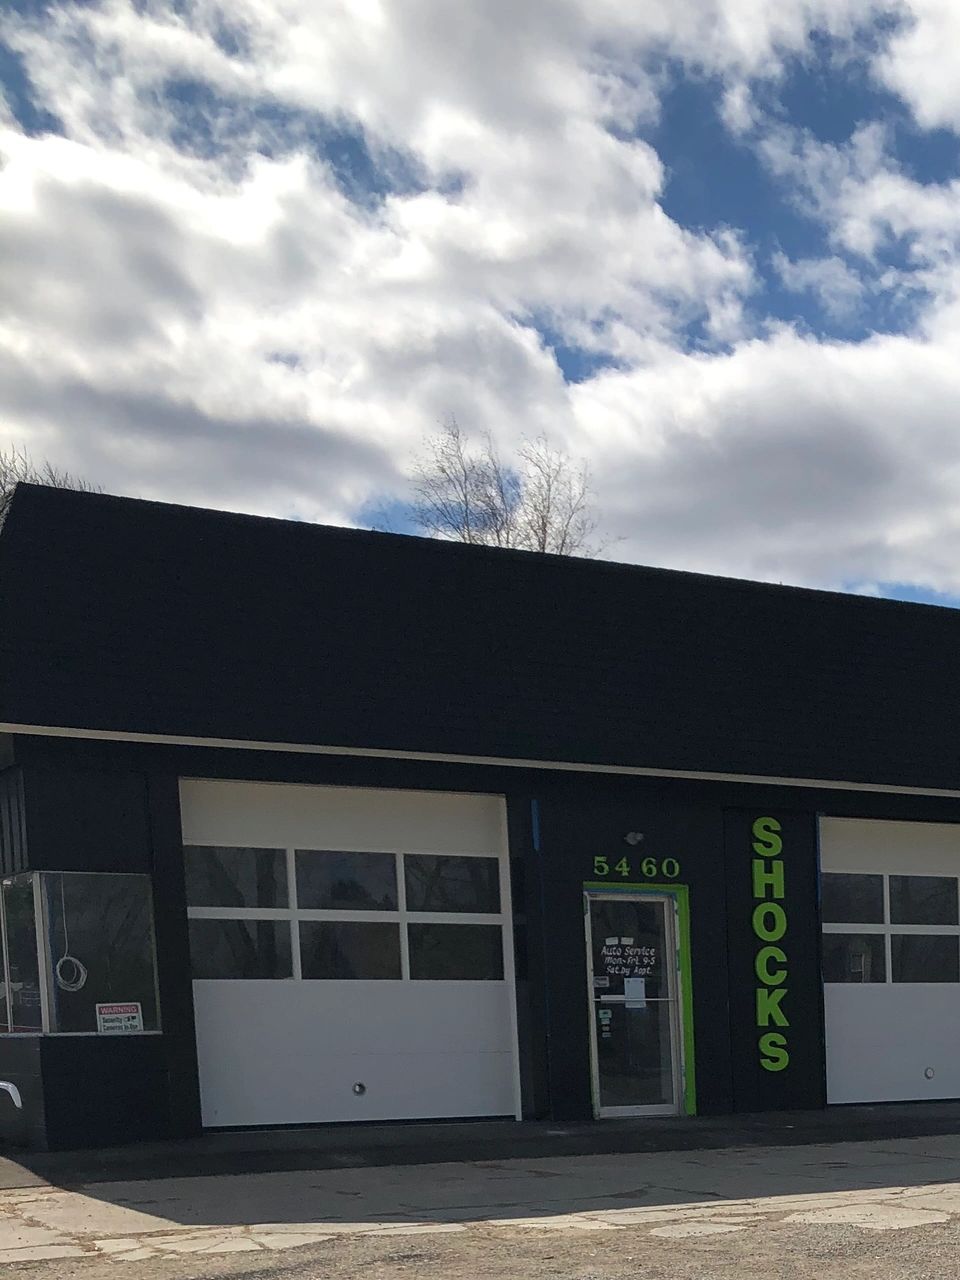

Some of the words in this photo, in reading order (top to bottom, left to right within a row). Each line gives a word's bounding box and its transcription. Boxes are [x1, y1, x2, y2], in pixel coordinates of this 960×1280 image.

[593, 856, 680, 878] 5460
[601, 946, 622, 955] Auto
[624, 946, 655, 955] Service
[752, 816, 789, 1072] SHOCKS
[100, 1006, 137, 1014] WARNING
